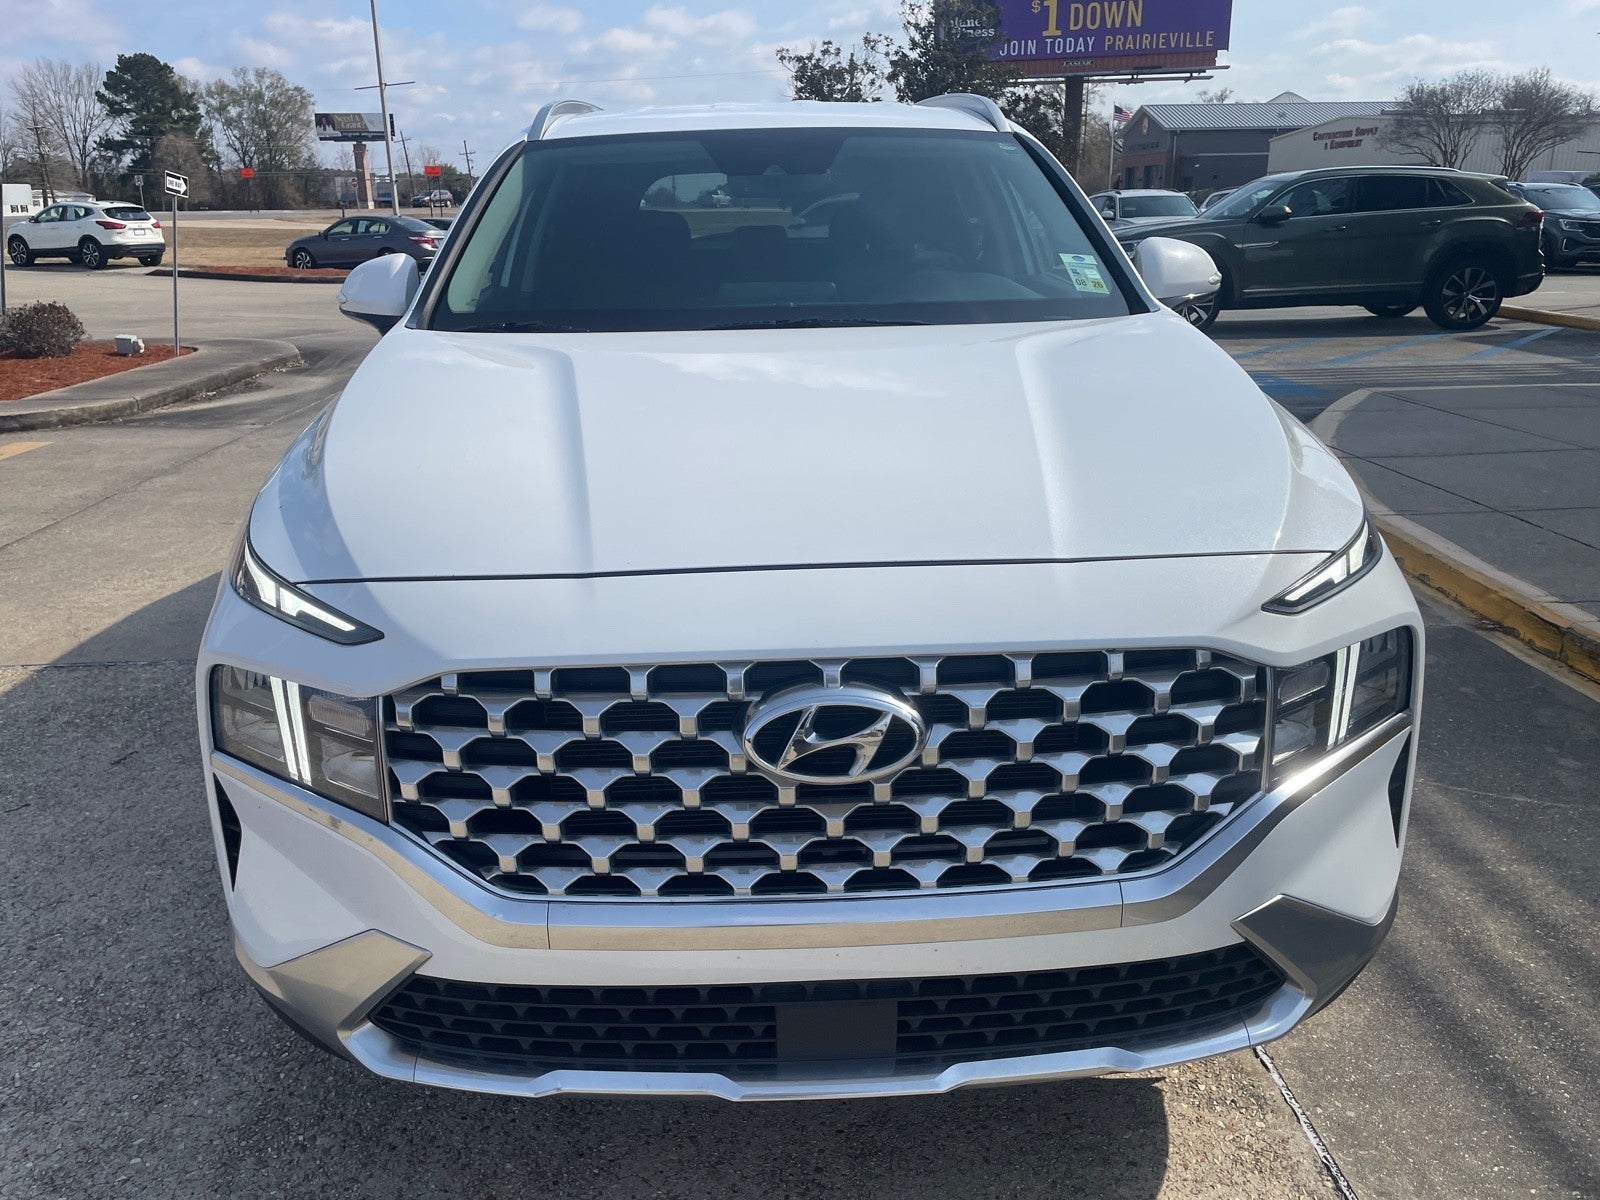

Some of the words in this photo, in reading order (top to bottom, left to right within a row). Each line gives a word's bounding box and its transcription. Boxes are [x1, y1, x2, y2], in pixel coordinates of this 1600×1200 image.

[1069, 0, 1143, 31] DOWN
[999, 39, 1037, 56] JOIN
[1045, 36, 1095, 54] TODAY
[1104, 31, 1215, 51] PRAIRIEVILLE
